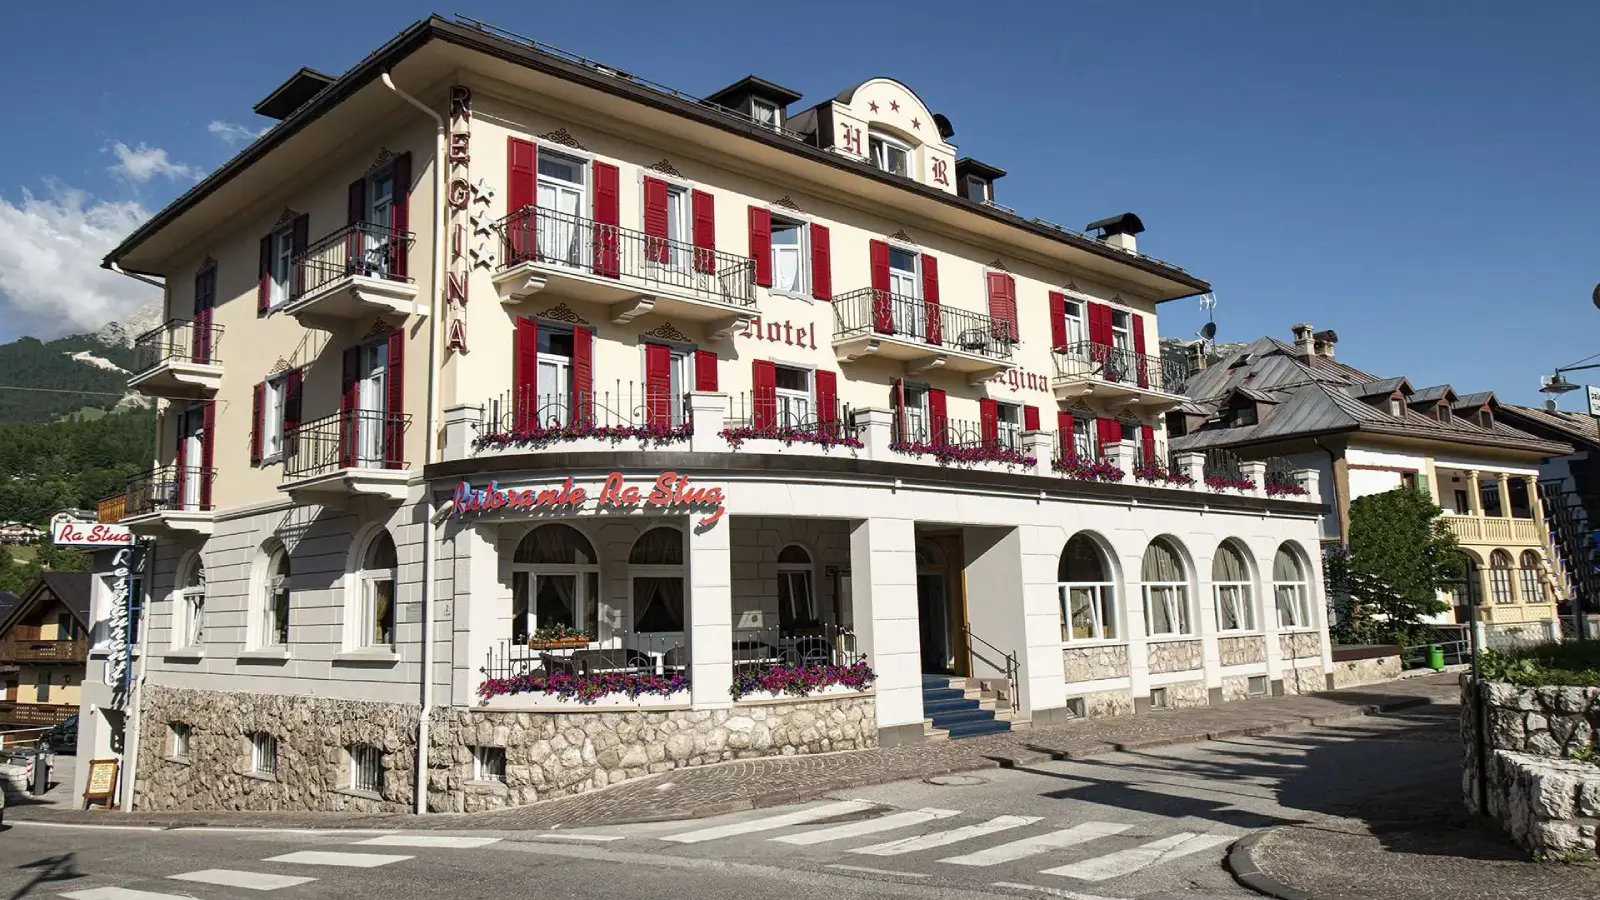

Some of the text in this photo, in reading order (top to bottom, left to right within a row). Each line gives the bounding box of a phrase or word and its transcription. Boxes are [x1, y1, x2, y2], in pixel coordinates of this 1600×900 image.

[447, 84, 471, 351] REGINA
[738, 315, 818, 351] Hotel
[453, 472, 725, 513] Ristorante Ra Stua
[59, 524, 132, 543] Ra Stua
